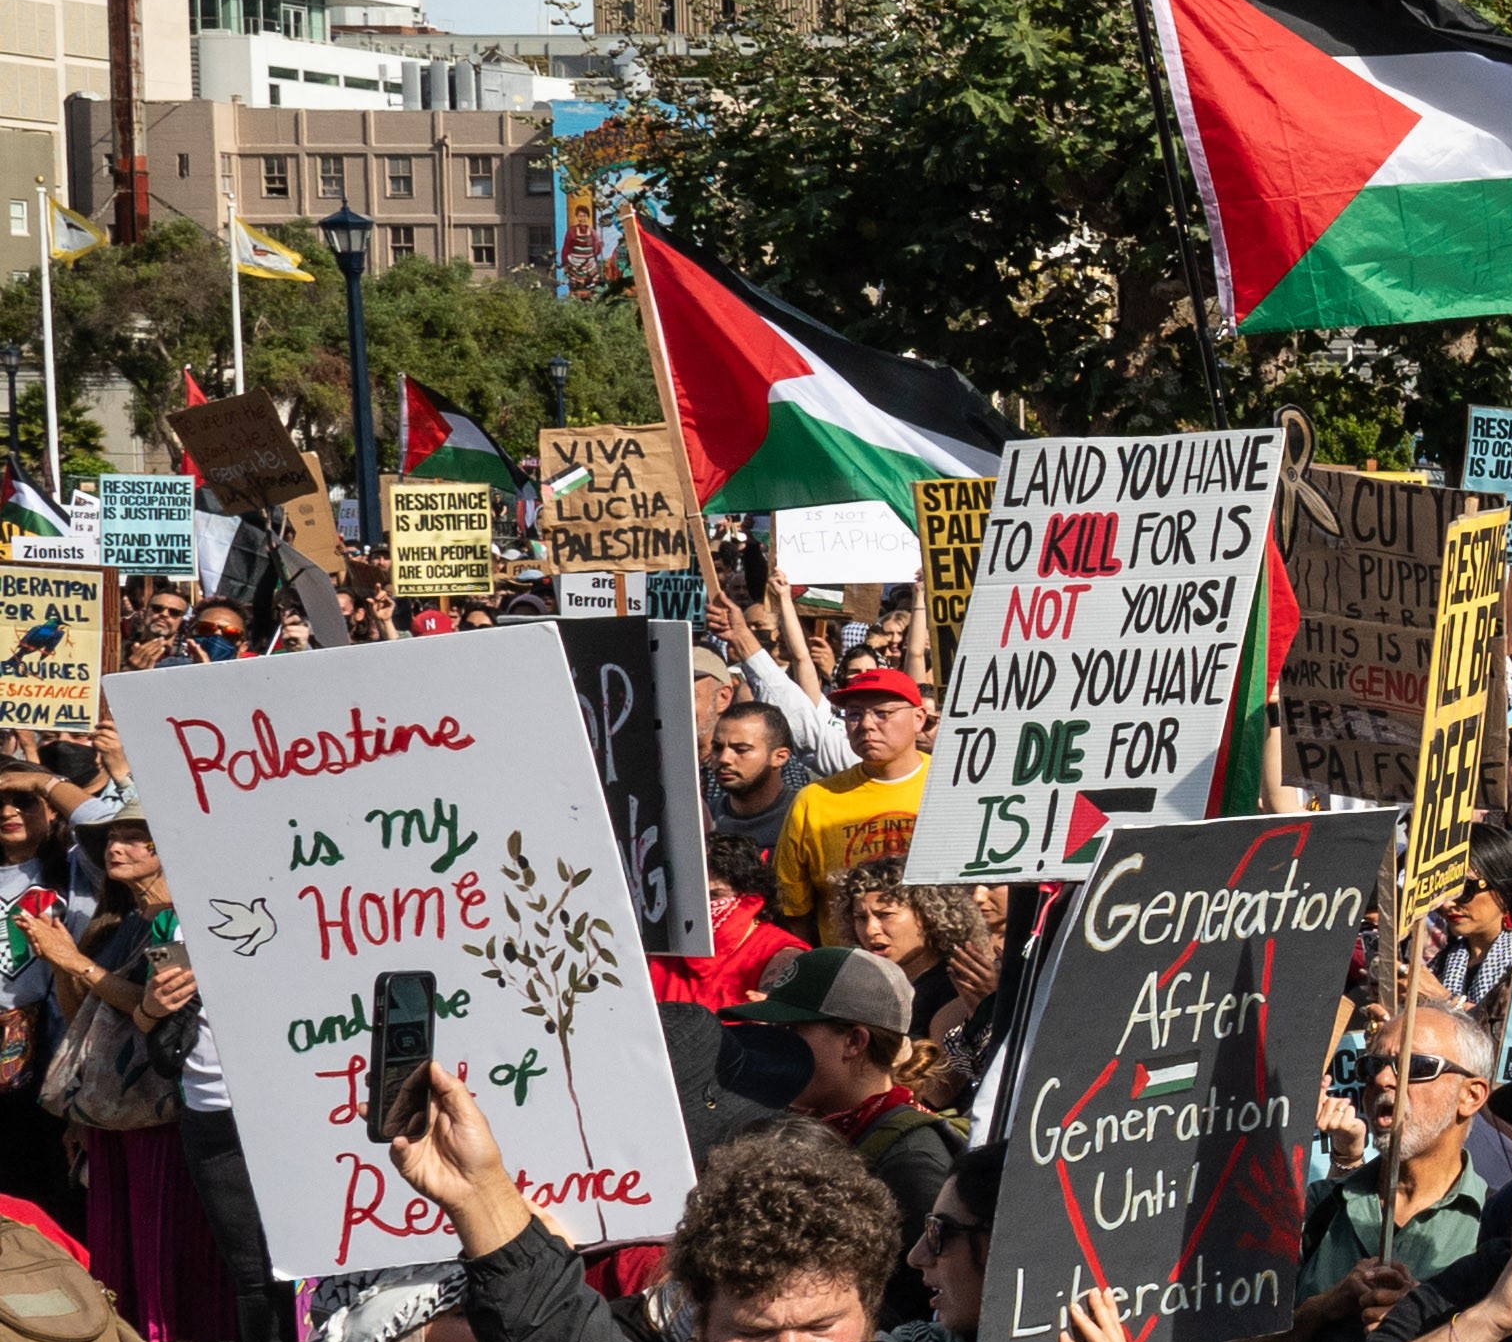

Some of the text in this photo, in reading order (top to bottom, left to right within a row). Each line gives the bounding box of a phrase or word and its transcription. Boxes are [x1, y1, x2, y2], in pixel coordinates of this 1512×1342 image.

[552, 439, 645, 464] VIVA
[587, 462, 635, 492] LA
[1004, 435, 1274, 507] LAND YOU HAVE
[103, 480, 190, 495] RESISTANCE
[104, 495, 191, 507] TO OCCUPATION
[104, 507, 191, 521] IS JUSTIFIED!
[556, 491, 674, 522] LUCHA
[104, 533, 191, 546] STAND WITH
[104, 549, 191, 564] PALESTINE
[551, 526, 687, 565] PALESTINA
[989, 505, 1252, 576] TO KILL FOR IS
[1001, 580, 1235, 647] NOT YOURS!
[949, 643, 1237, 718] LAND YOU HAVE
[166, 706, 474, 814] Palestine
[953, 718, 1179, 786] TO DIE FOR
[289, 798, 479, 872] is my
[1084, 853, 1362, 952] Generation
[1116, 971, 1267, 1055] After
[489, 1048, 547, 1106] of
[1029, 1076, 1290, 1165] Generation
[1094, 1164, 1200, 1231] Until
